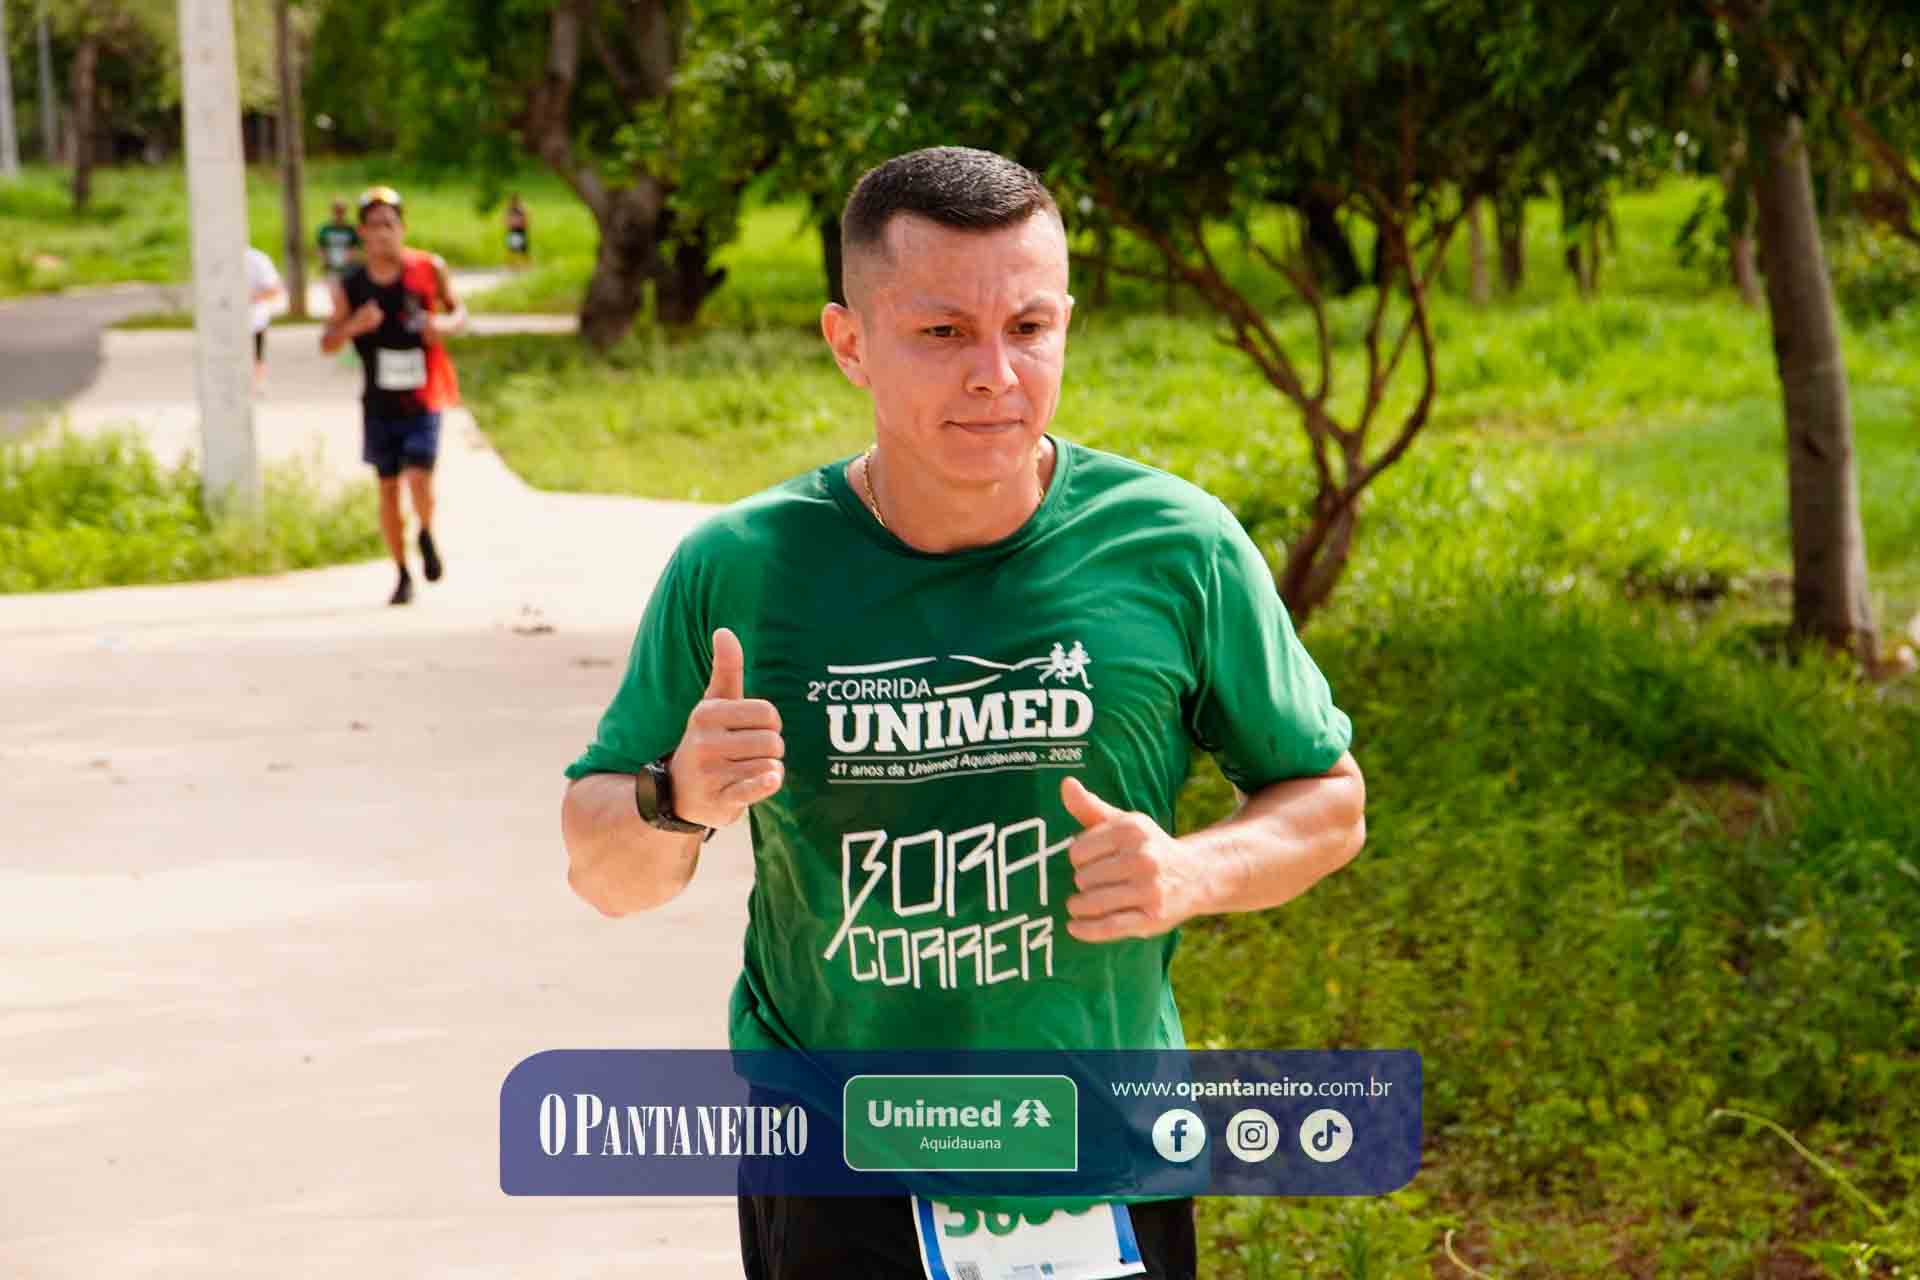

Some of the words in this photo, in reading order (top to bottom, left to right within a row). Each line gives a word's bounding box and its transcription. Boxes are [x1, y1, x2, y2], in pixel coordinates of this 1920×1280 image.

[826, 689, 1094, 753] UNIMED
[827, 677, 932, 701] CORRIDA
[830, 762, 848, 776] 41
[850, 764, 885, 777] anos
[887, 762, 905, 777] da
[908, 755, 959, 777] Unimed
[824, 817, 1075, 961] BORA
[848, 913, 1054, 990] CORRER
